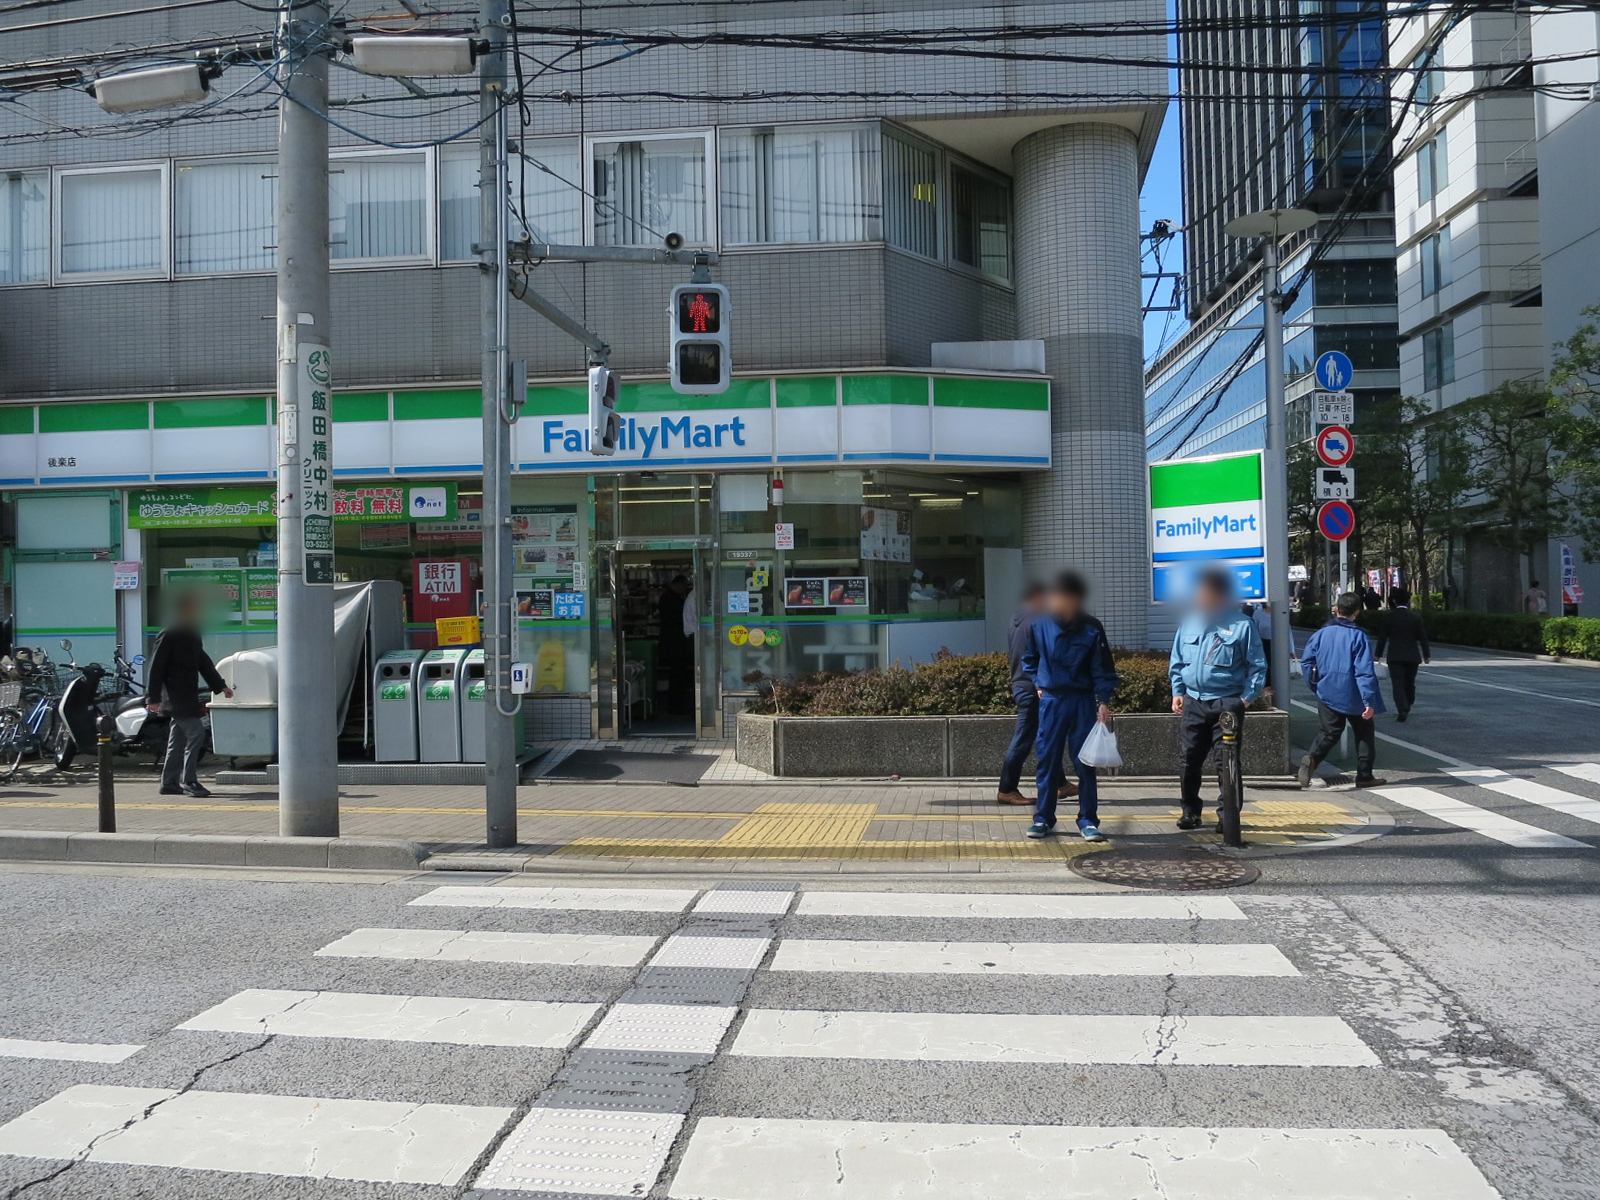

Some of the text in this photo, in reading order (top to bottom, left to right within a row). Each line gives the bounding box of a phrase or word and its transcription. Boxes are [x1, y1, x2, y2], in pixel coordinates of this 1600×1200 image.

[1320, 413, 1328, 422] 10
[1342, 413, 1350, 422] 18
[311, 390, 328, 511] 飯田橋中村
[48, 457, 76, 467] 後楽店
[303, 458, 313, 511] クリニック
[1336, 488, 1342, 497] 3
[140, 501, 269, 518] ゆうちょキャッシュカード
[371, 498, 403, 514] 無料
[1156, 514, 1257, 539] FamilyMart
[424, 564, 456, 580] 銀行
[425, 581, 456, 593] ATM
[555, 594, 584, 604] たばこ
[558, 605, 581, 616] お酒
